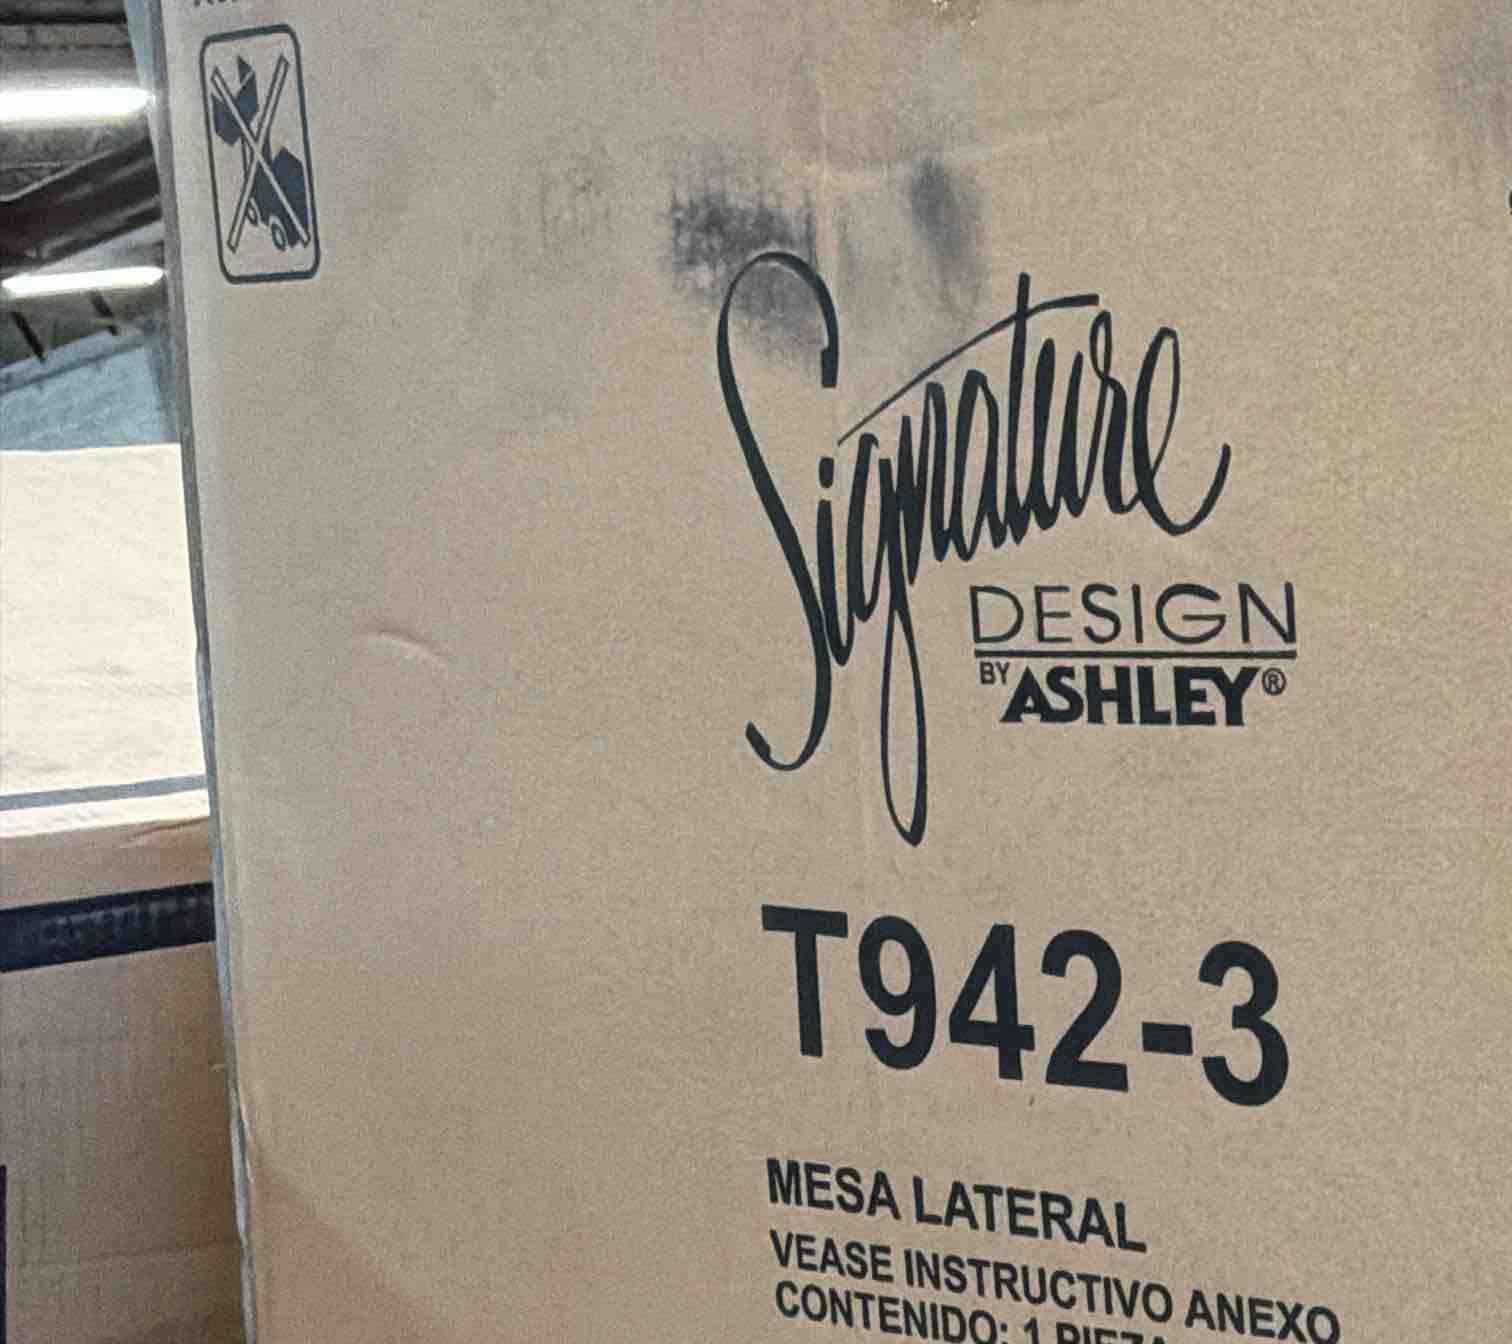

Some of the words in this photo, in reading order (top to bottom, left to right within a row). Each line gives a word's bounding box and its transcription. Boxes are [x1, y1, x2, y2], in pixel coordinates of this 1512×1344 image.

[716, 250, 1232, 847] Signature
[968, 580, 1298, 646] DESIGN
[979, 660, 1012, 687] BY
[760, 903, 1290, 1107] T942-3
[765, 1157, 901, 1221] MESA
[912, 1175, 1148, 1253] LATERAL
[768, 1228, 895, 1284] VEASE
[903, 1249, 1174, 1324] INSTRUCTIVO
